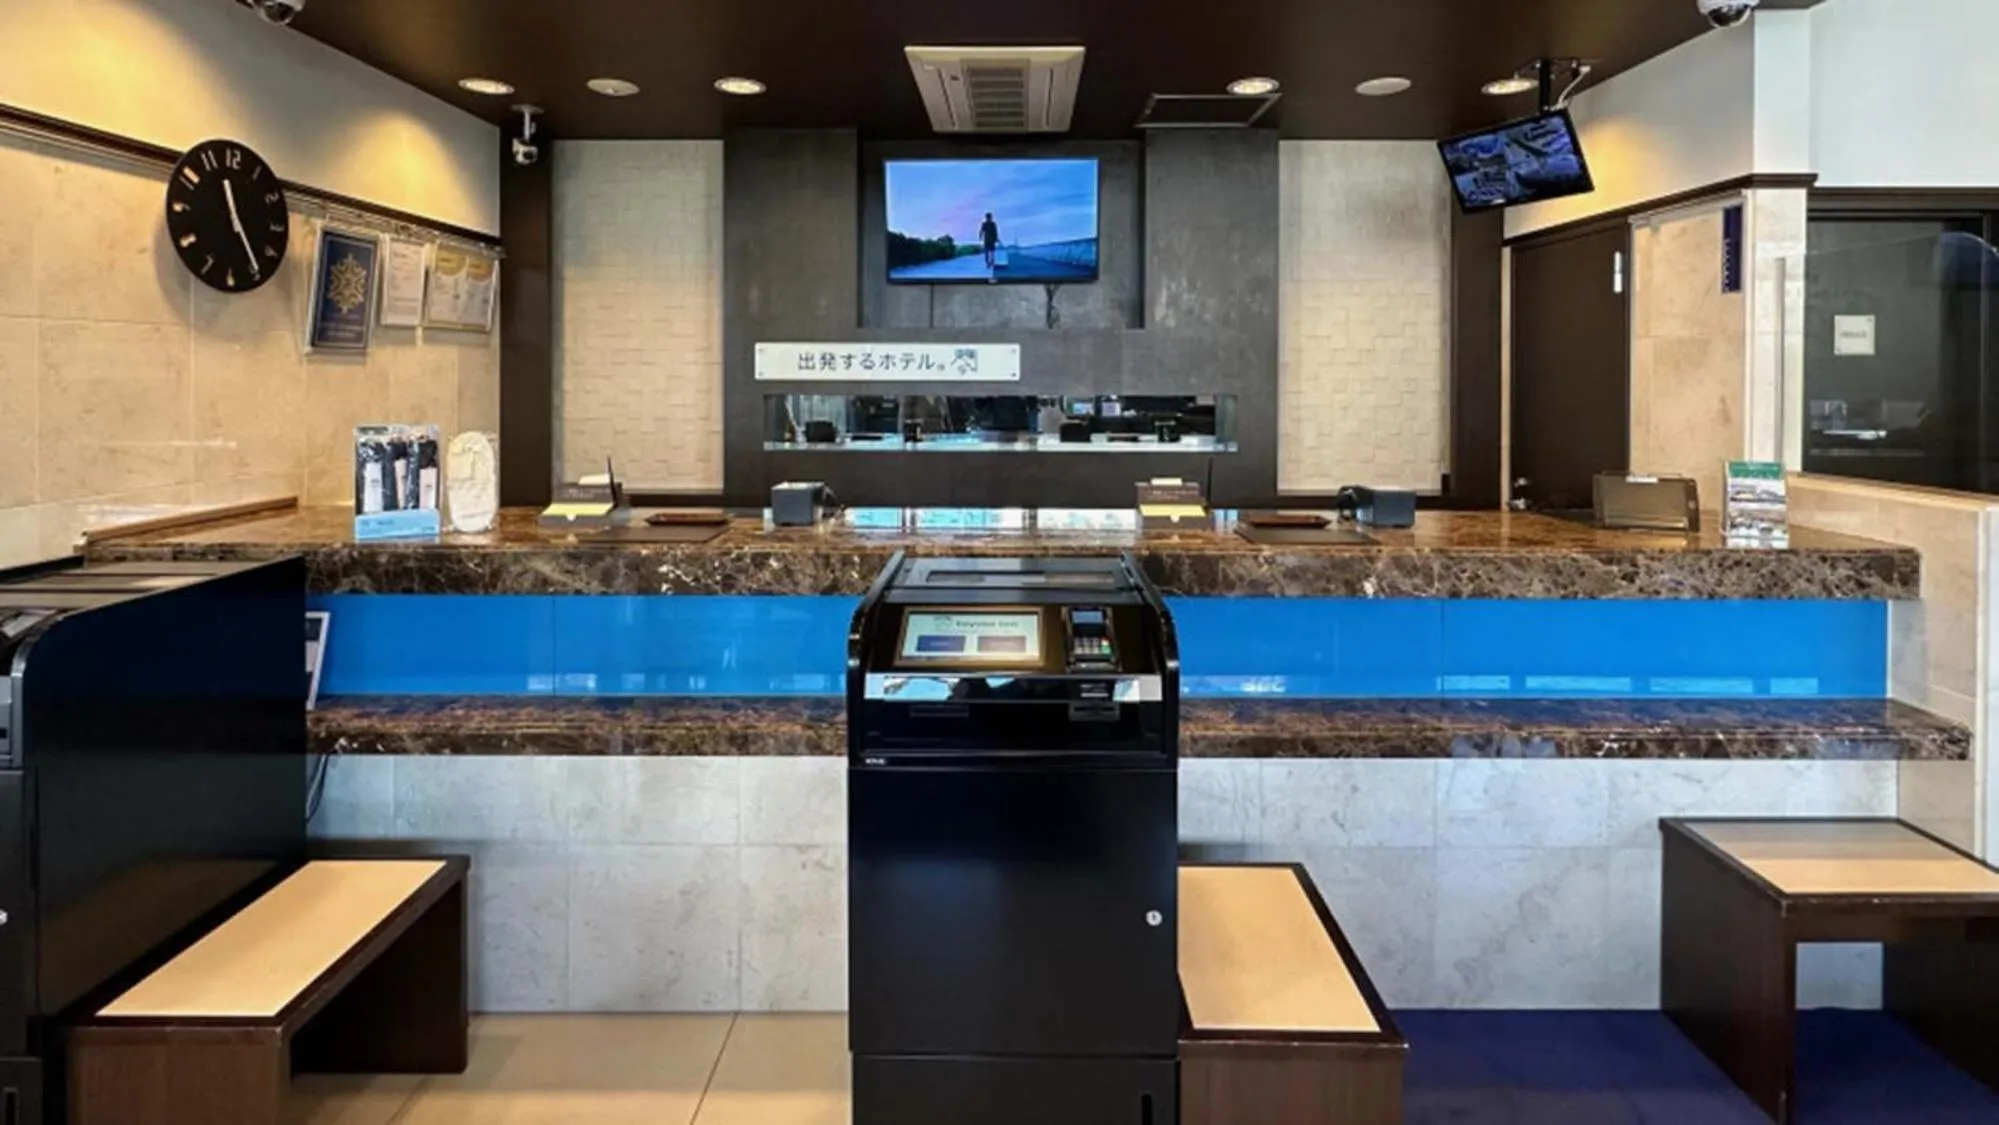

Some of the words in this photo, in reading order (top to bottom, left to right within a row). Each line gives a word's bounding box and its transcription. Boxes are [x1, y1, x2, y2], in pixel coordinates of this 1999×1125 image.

[201, 150, 219, 171] 11
[225, 148, 241, 170] 12
[252, 166, 262, 181] 1
[172, 202, 191, 212] 9
[265, 192, 280, 205] 2
[201, 254, 214, 275] 7
[798, 352, 945, 371] 出発するホテル。
